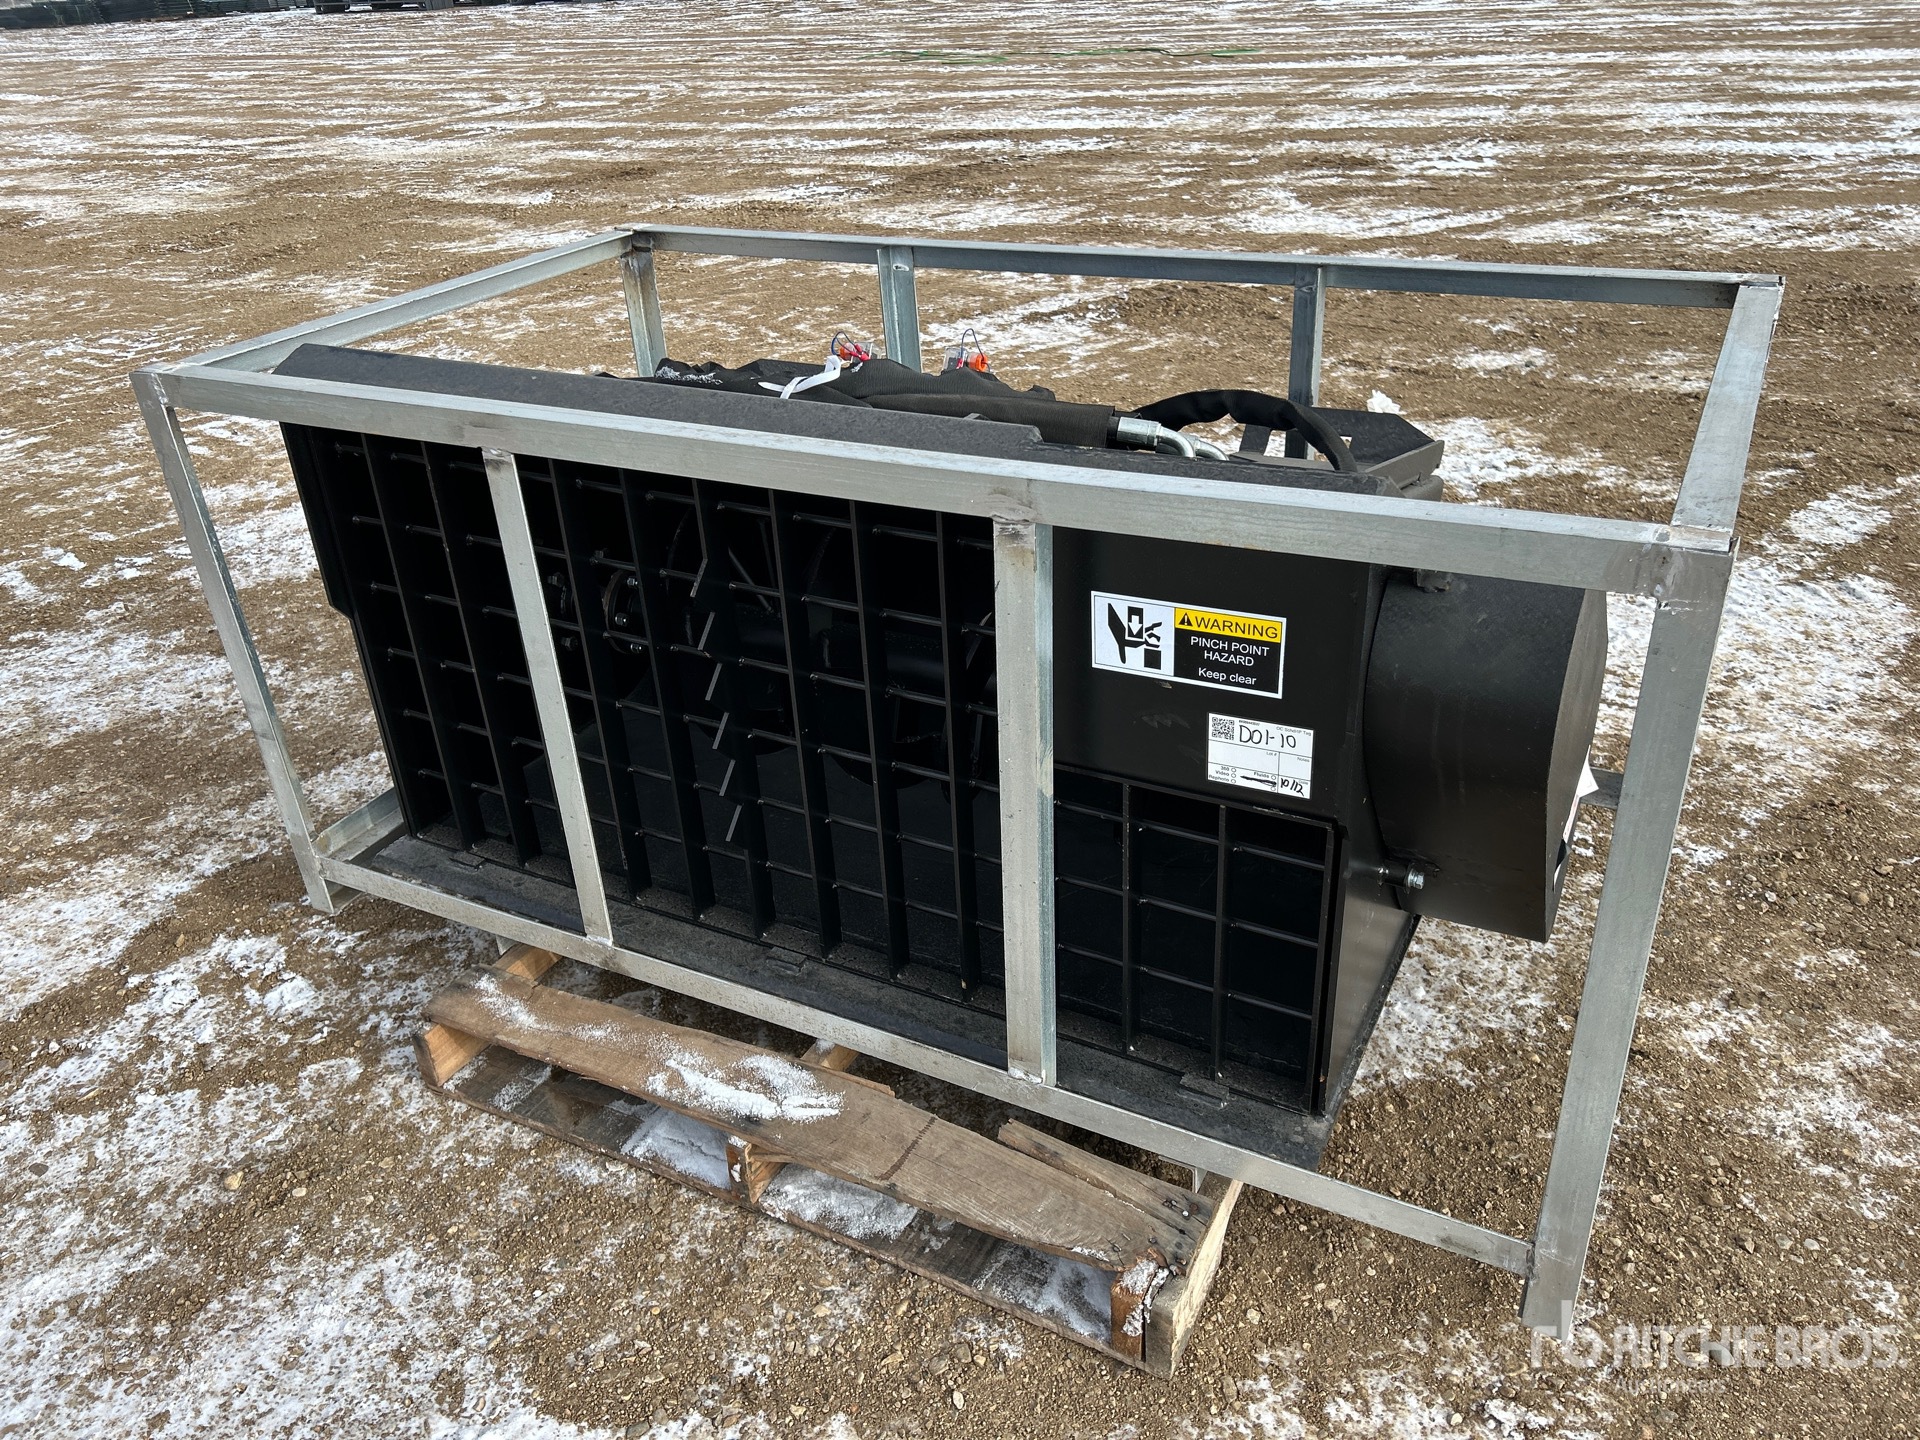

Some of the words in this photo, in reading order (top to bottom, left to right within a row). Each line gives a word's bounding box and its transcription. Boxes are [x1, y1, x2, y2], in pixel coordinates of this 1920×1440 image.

[1194, 616, 1278, 639] WARNING
[1190, 636, 1228, 651] PINCH
[1231, 642, 1270, 657] POINT
[1204, 650, 1254, 666] HAZARD
[1198, 667, 1227, 682] Keep
[1229, 673, 1257, 685] clear
